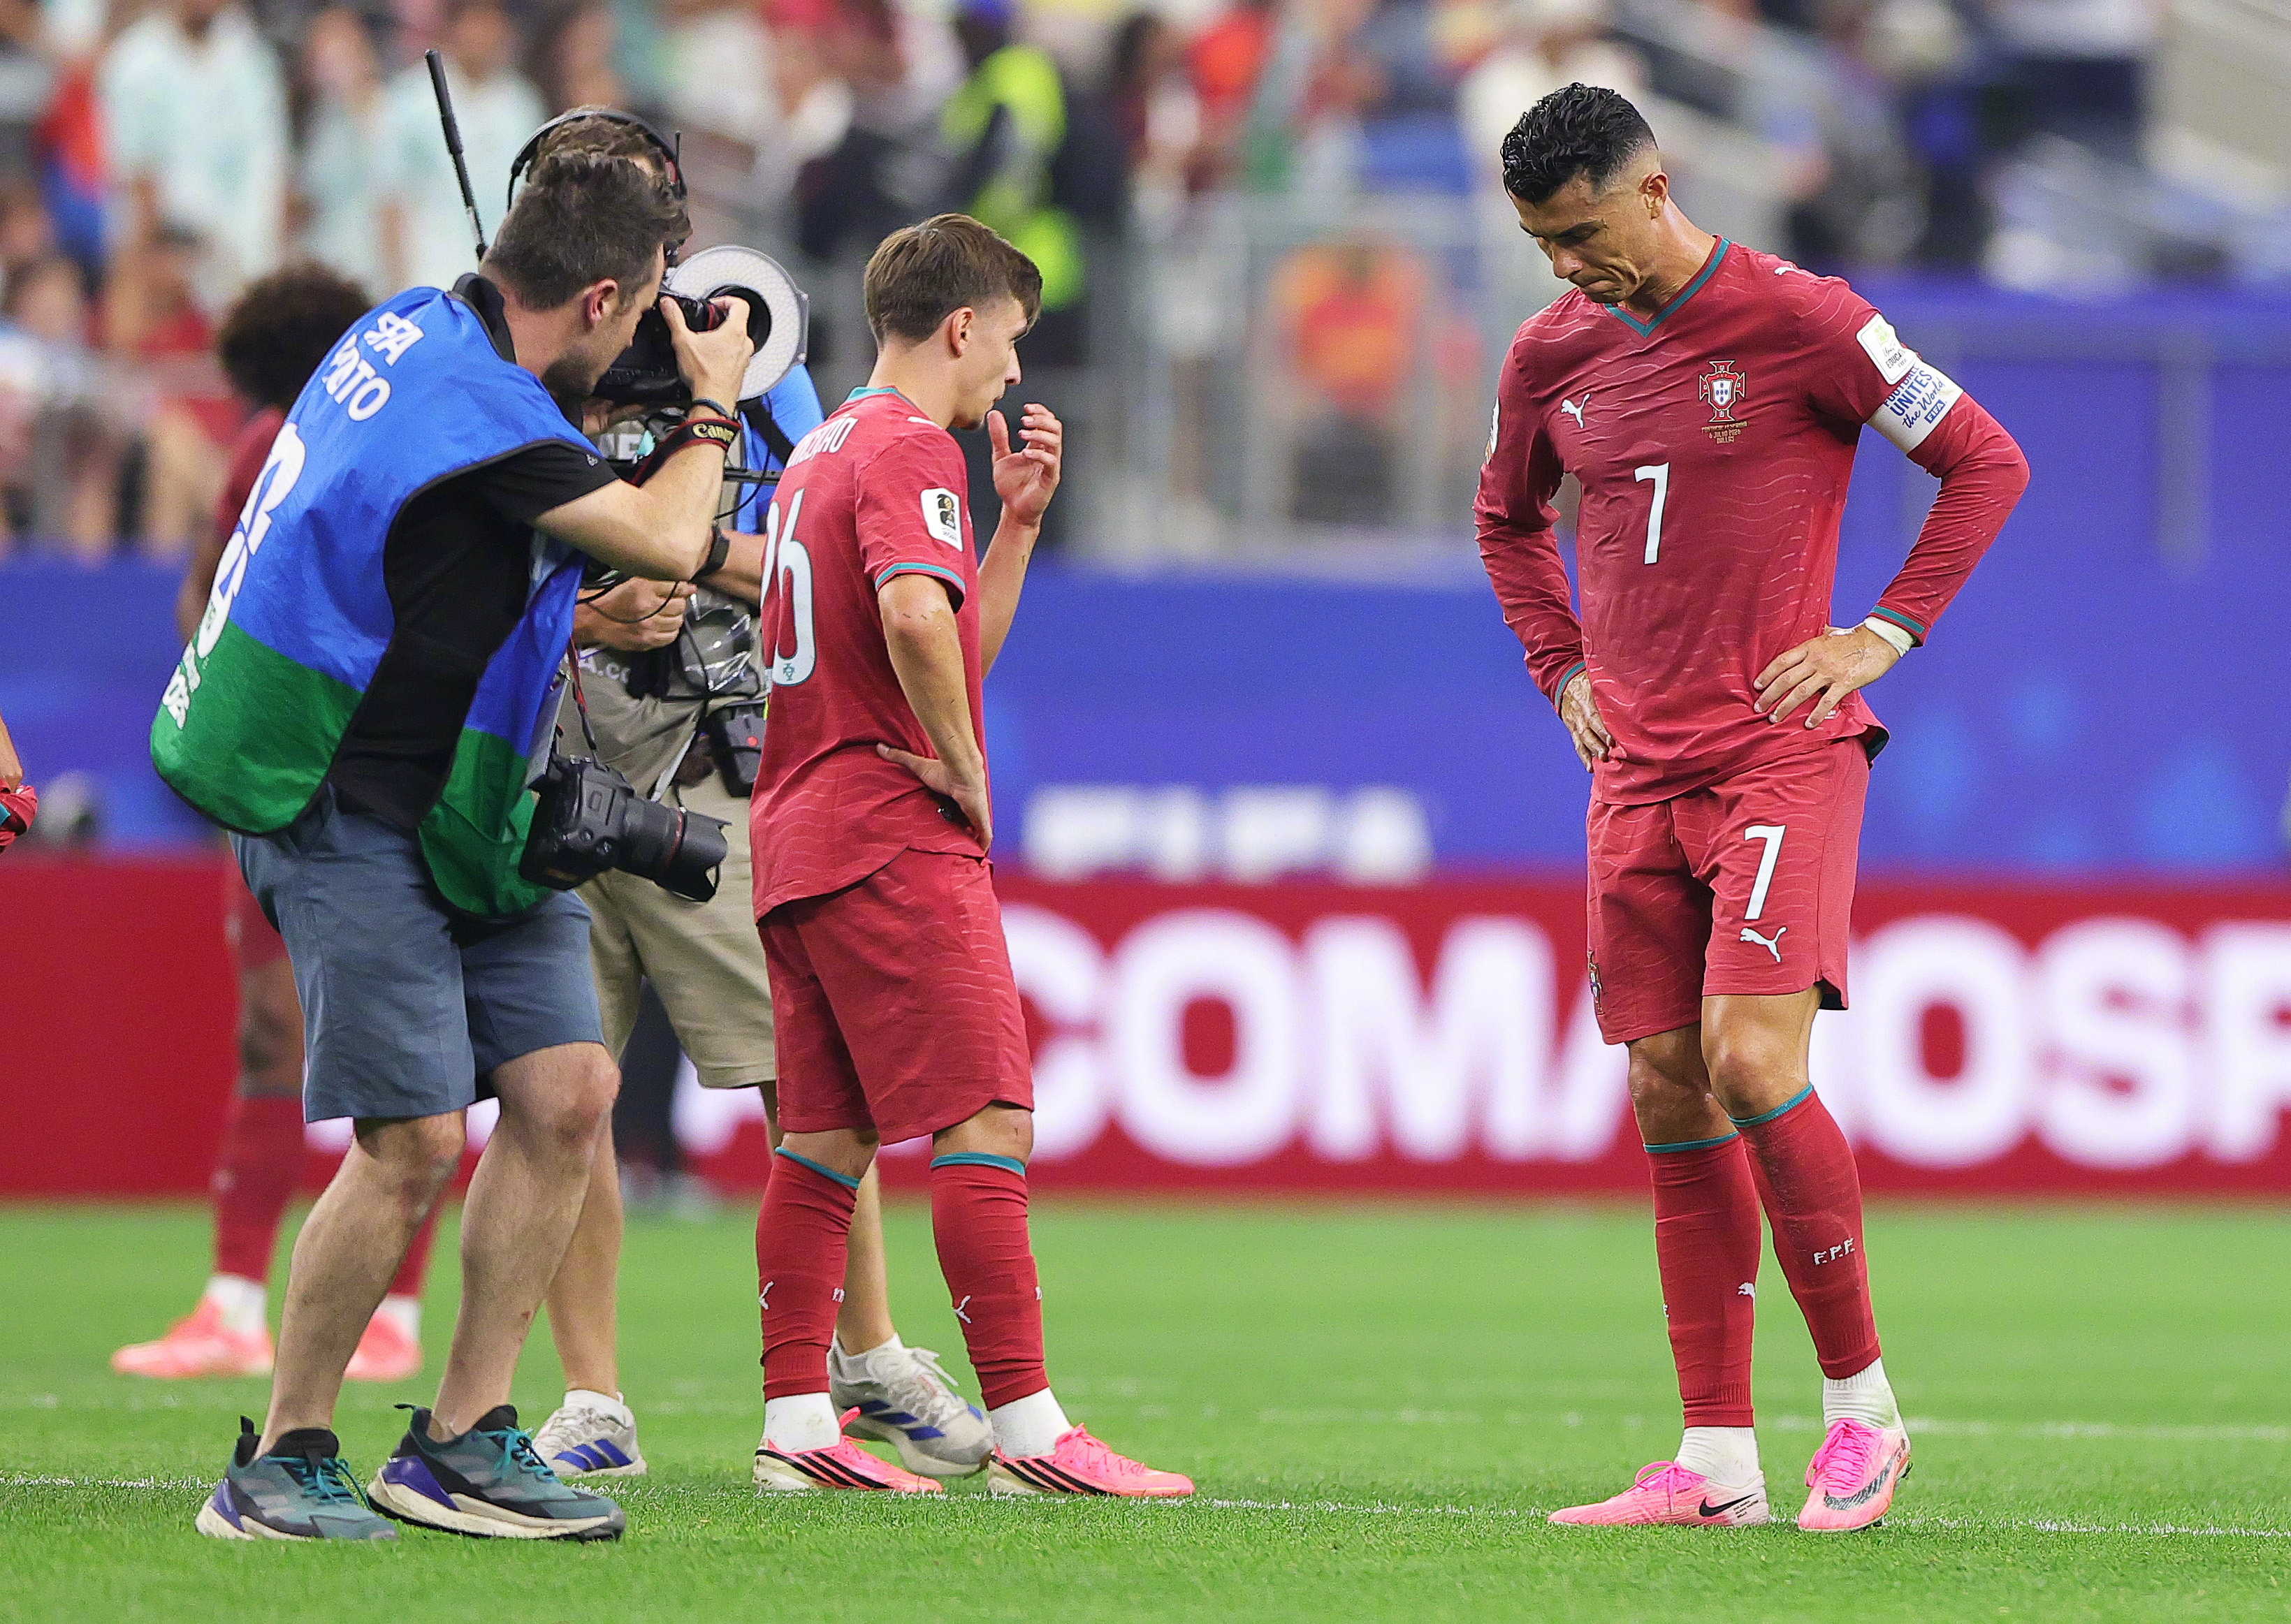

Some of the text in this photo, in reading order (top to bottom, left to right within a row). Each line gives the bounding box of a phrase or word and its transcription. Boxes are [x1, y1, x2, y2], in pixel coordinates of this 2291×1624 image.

[1890, 370, 1933, 417] UNITES
[1903, 377, 1946, 428] the World
[1926, 400, 1946, 422] FIFA
[1634, 462, 1670, 564] 7
[1024, 784, 1431, 884] FIFA
[1744, 824, 1787, 920] 7
